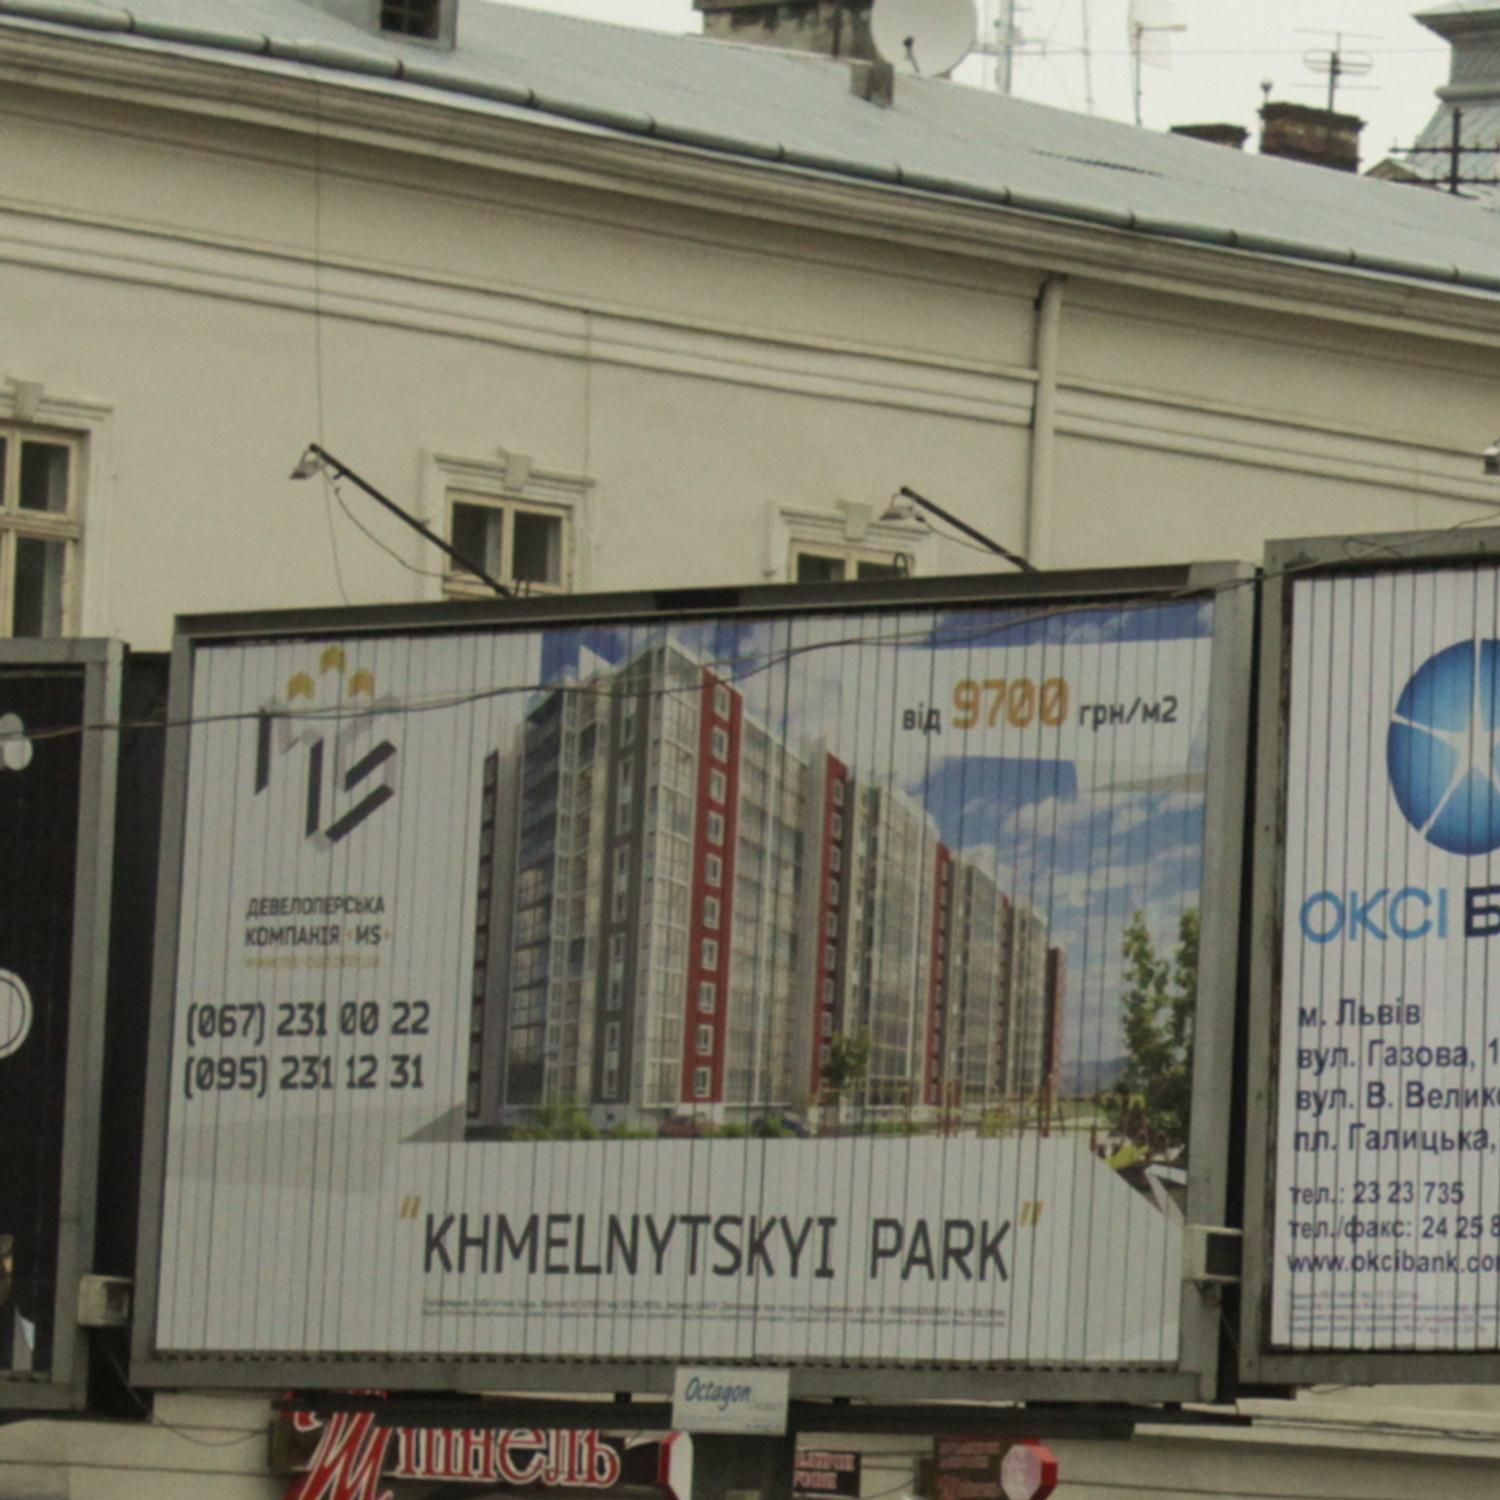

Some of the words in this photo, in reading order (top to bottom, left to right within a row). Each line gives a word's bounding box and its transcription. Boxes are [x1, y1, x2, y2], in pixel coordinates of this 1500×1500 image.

[902, 702, 941, 735] від
[952, 676, 1070, 729] 9700
[1079, 695, 1178, 731] грн/м2
[246, 895, 386, 919] ДЕВЕЛОПЕРСЬКА
[1300, 886, 1448, 944] ОКСІ
[245, 925, 340, 947] КОМПАНІЯ
[186, 1001, 266, 1046] (067)
[277, 1002, 328, 1036] 231
[340, 1002, 380, 1036] 00
[391, 1001, 430, 1035] 22
[1299, 1005, 1326, 1027] м.
[1336, 998, 1421, 1026] Львів
[1297, 1046, 1356, 1076] вул.
[1367, 1039, 1476, 1070] Газова,
[183, 1054, 267, 1098] (095)
[279, 1055, 333, 1089] 231
[346, 1055, 378, 1088] 12
[390, 1054, 424, 1088] 31
[1296, 1088, 1354, 1117] вул.
[1366, 1081, 1393, 1109] В.
[1294, 1130, 1337, 1152] пл.
[1349, 1123, 1496, 1155] Галицька,
[1290, 1183, 1344, 1206] тел.:
[1353, 1182, 1381, 1204] 23
[1387, 1182, 1415, 1204] 23
[1424, 1182, 1464, 1204] 735
[1289, 1215, 1412, 1244] тел./факс:
[1421, 1216, 1448, 1238] 24
[1455, 1216, 1483, 1238] 25
